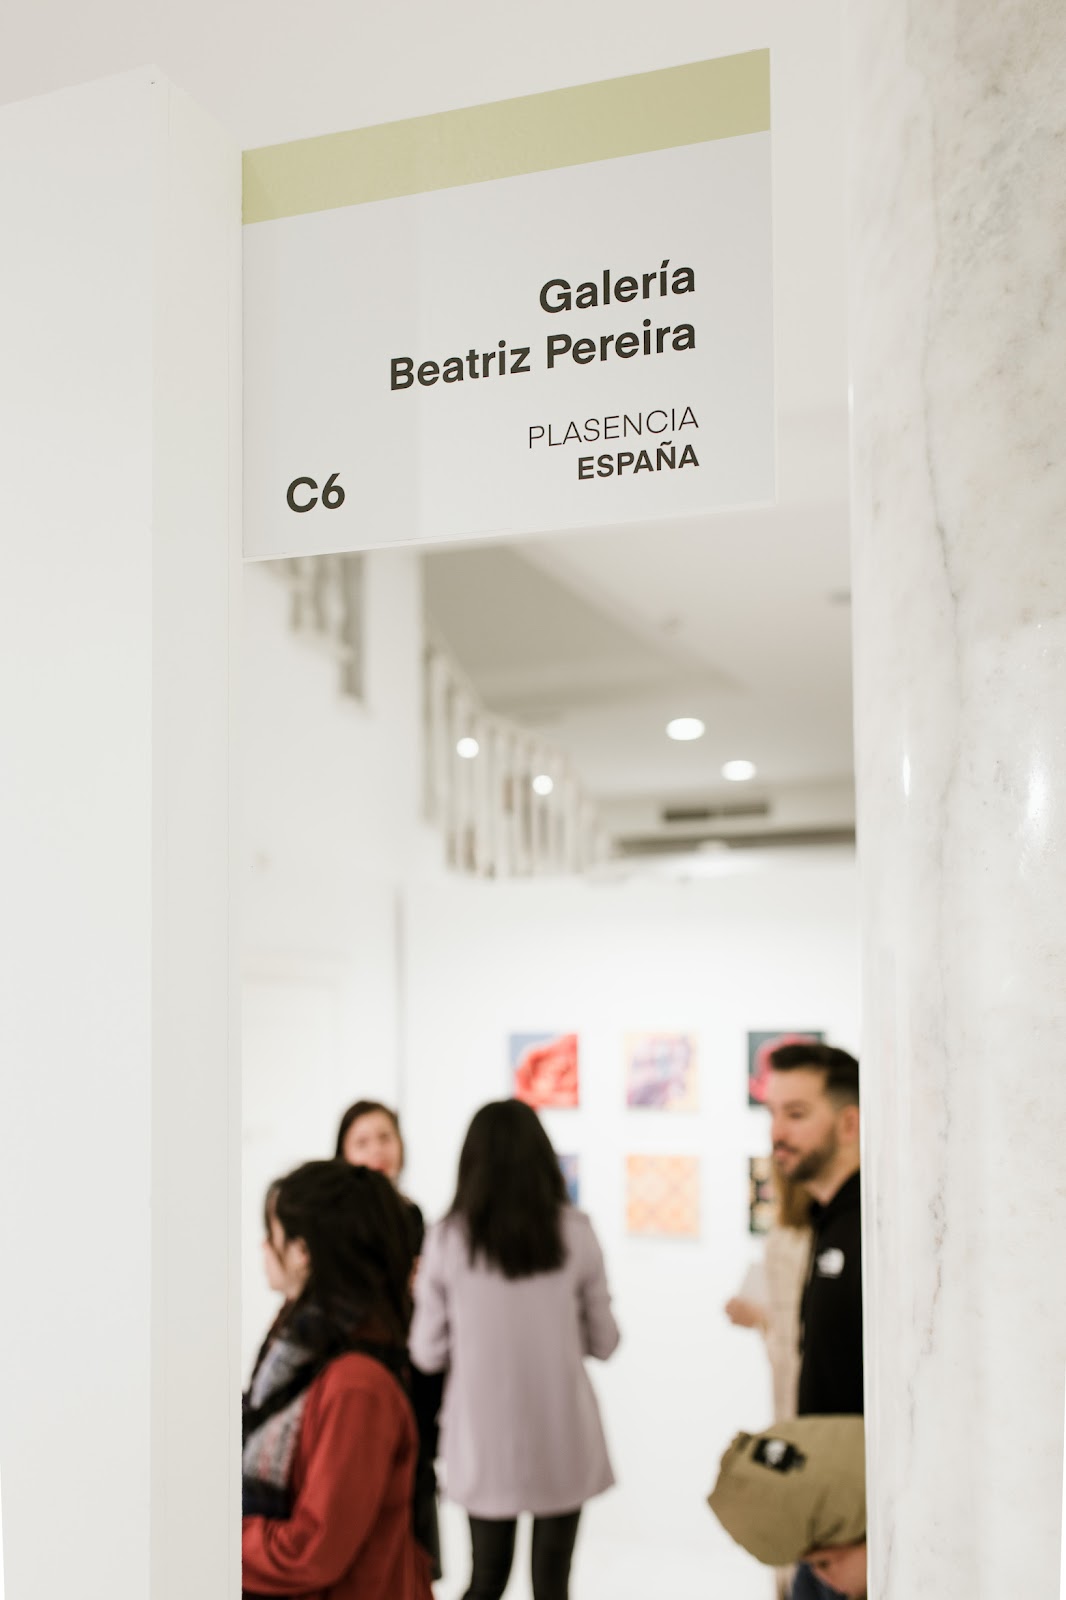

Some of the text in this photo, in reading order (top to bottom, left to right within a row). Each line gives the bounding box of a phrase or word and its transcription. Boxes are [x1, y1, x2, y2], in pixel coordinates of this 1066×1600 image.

[539, 259, 696, 314] Galería
[390, 318, 696, 391] Beatriz Pereira
[528, 406, 700, 449] PLASENCIA
[578, 440, 700, 481] ESPAÑA
[286, 472, 346, 514] C6
